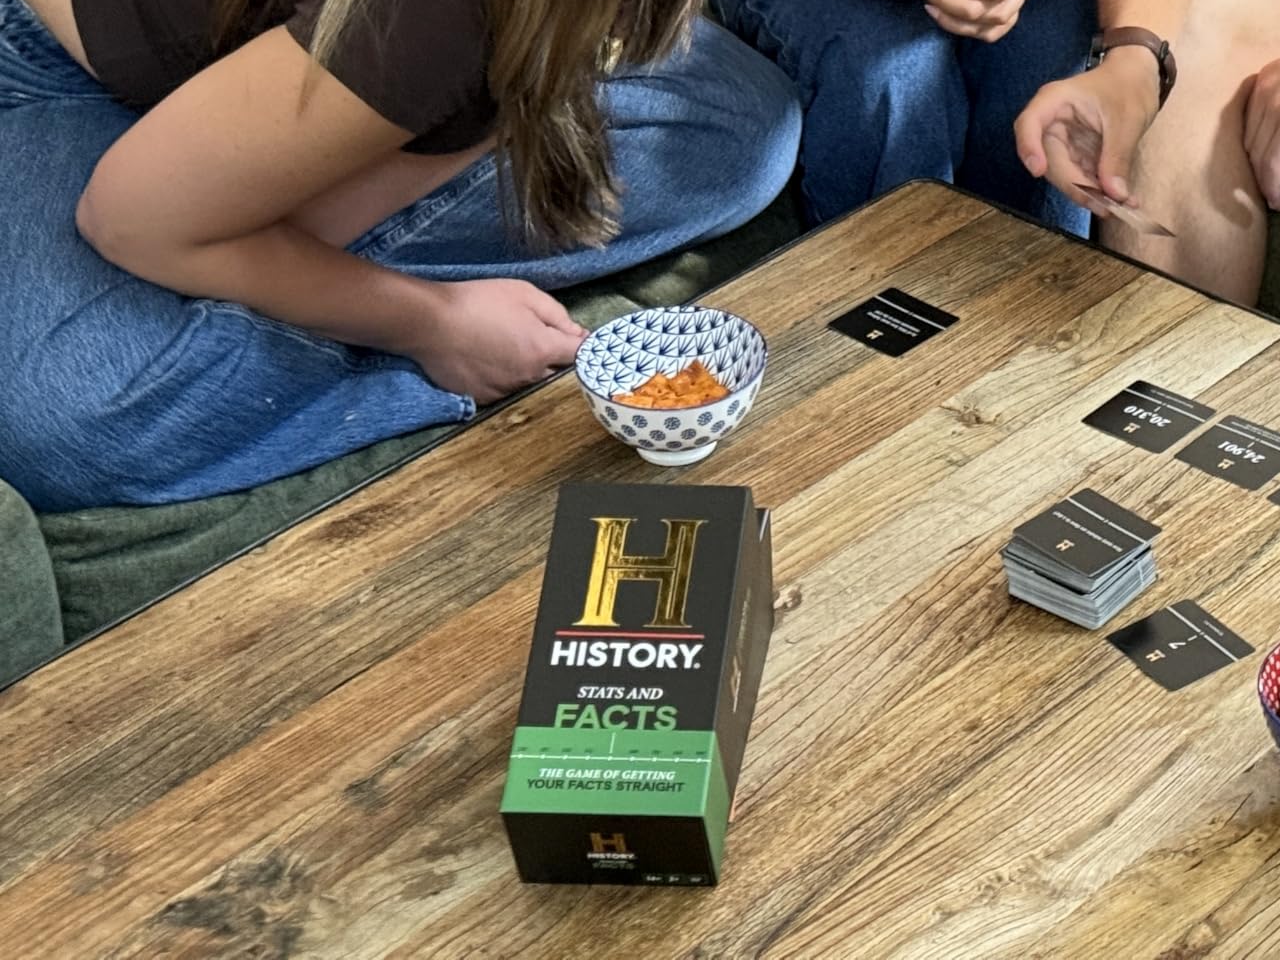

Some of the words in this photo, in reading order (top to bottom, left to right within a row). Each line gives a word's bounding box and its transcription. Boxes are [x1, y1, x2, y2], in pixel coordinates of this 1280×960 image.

[1123, 405, 1172, 427] 20,310
[1218, 440, 1266, 463] 24,901
[571, 518, 709, 628] H
[577, 686, 625, 700] STATS
[626, 688, 664, 700] AND
[554, 703, 678, 731] FACTS
[539, 768, 564, 778] THE
[566, 768, 602, 779] GAME
[602, 769, 621, 780] OF
[621, 770, 676, 780] GETTING
[527, 779, 565, 790] YOUR
[567, 780, 613, 791] FACTS
[615, 781, 686, 792] STRAIGHT
[590, 832, 627, 853] H
